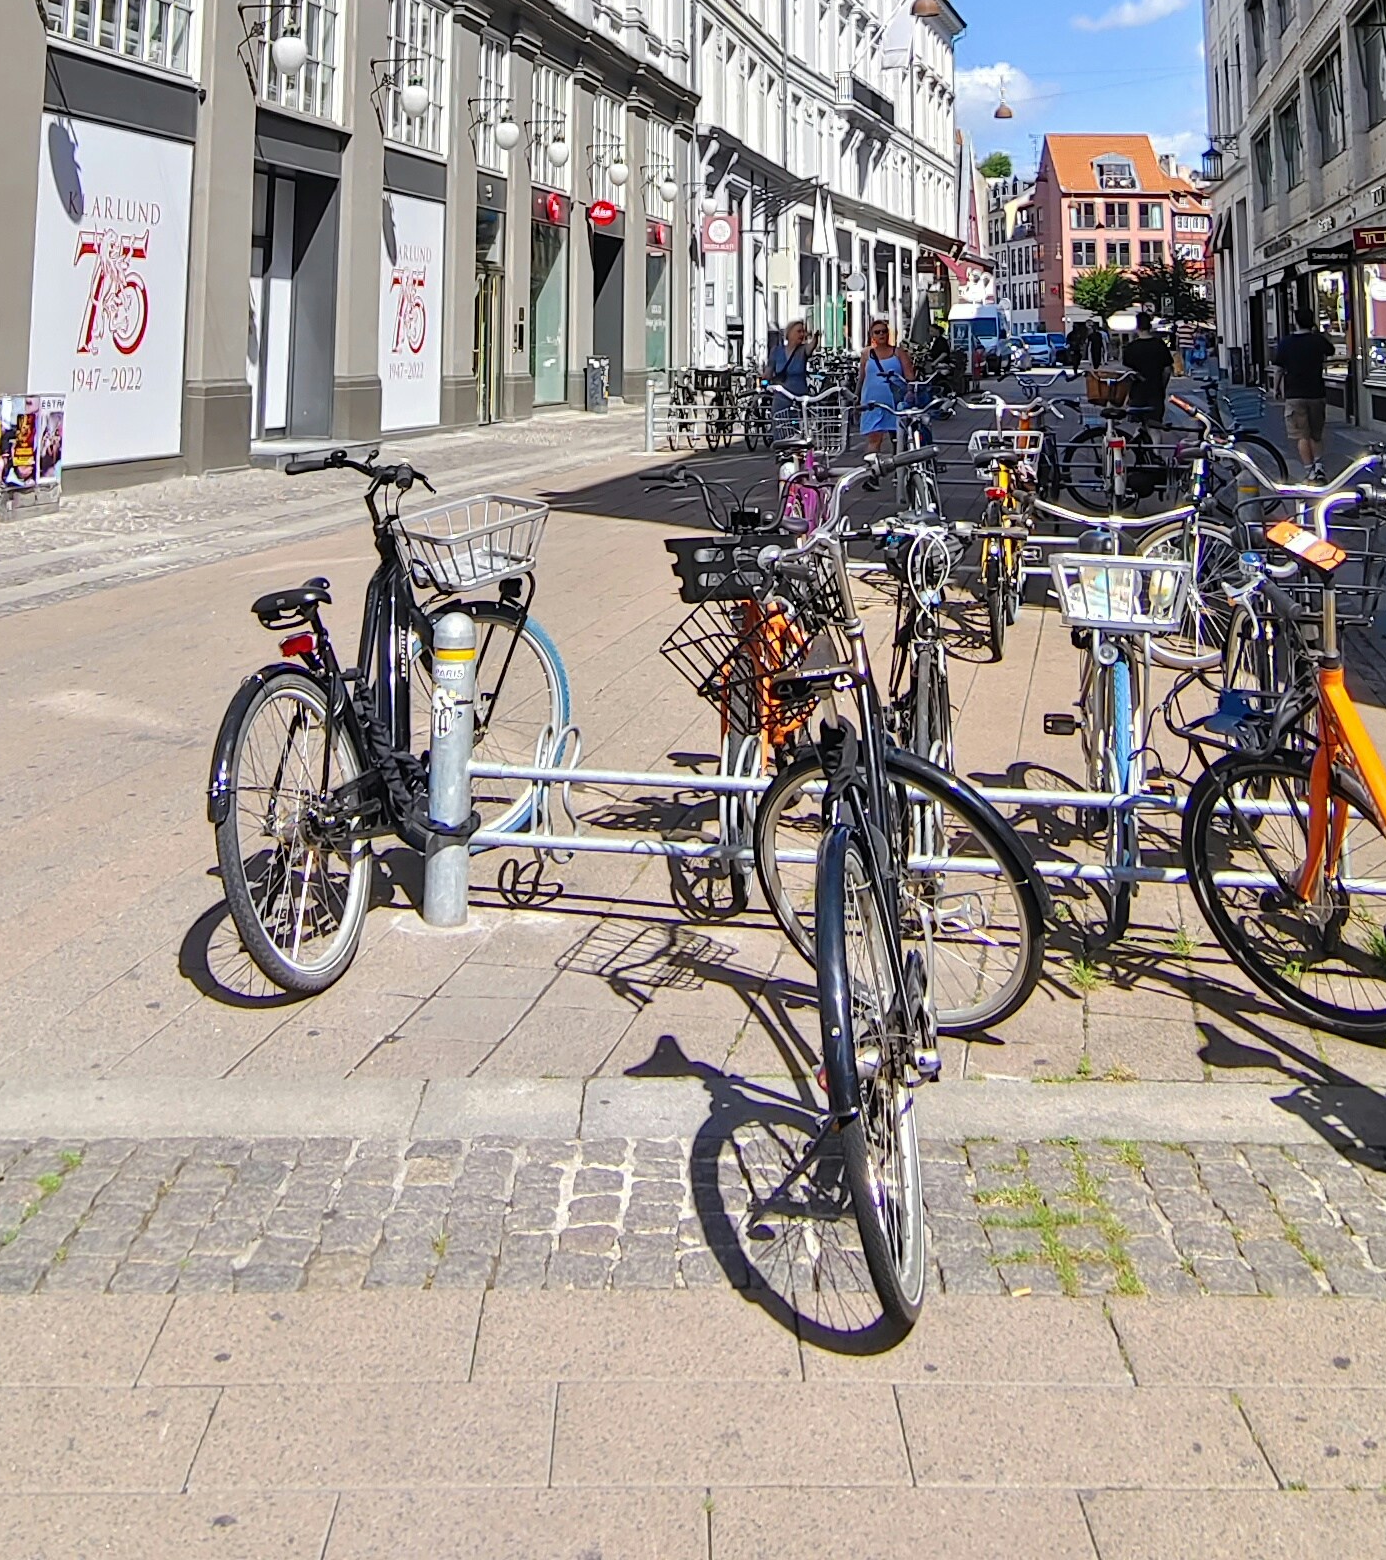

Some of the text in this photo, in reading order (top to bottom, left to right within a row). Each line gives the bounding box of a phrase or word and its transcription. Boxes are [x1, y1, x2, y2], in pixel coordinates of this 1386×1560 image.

[67, 190, 162, 226] KLARLUND
[73, 227, 151, 355] 75
[389, 266, 427, 354] 75
[71, 365, 143, 393] 1947-2022
